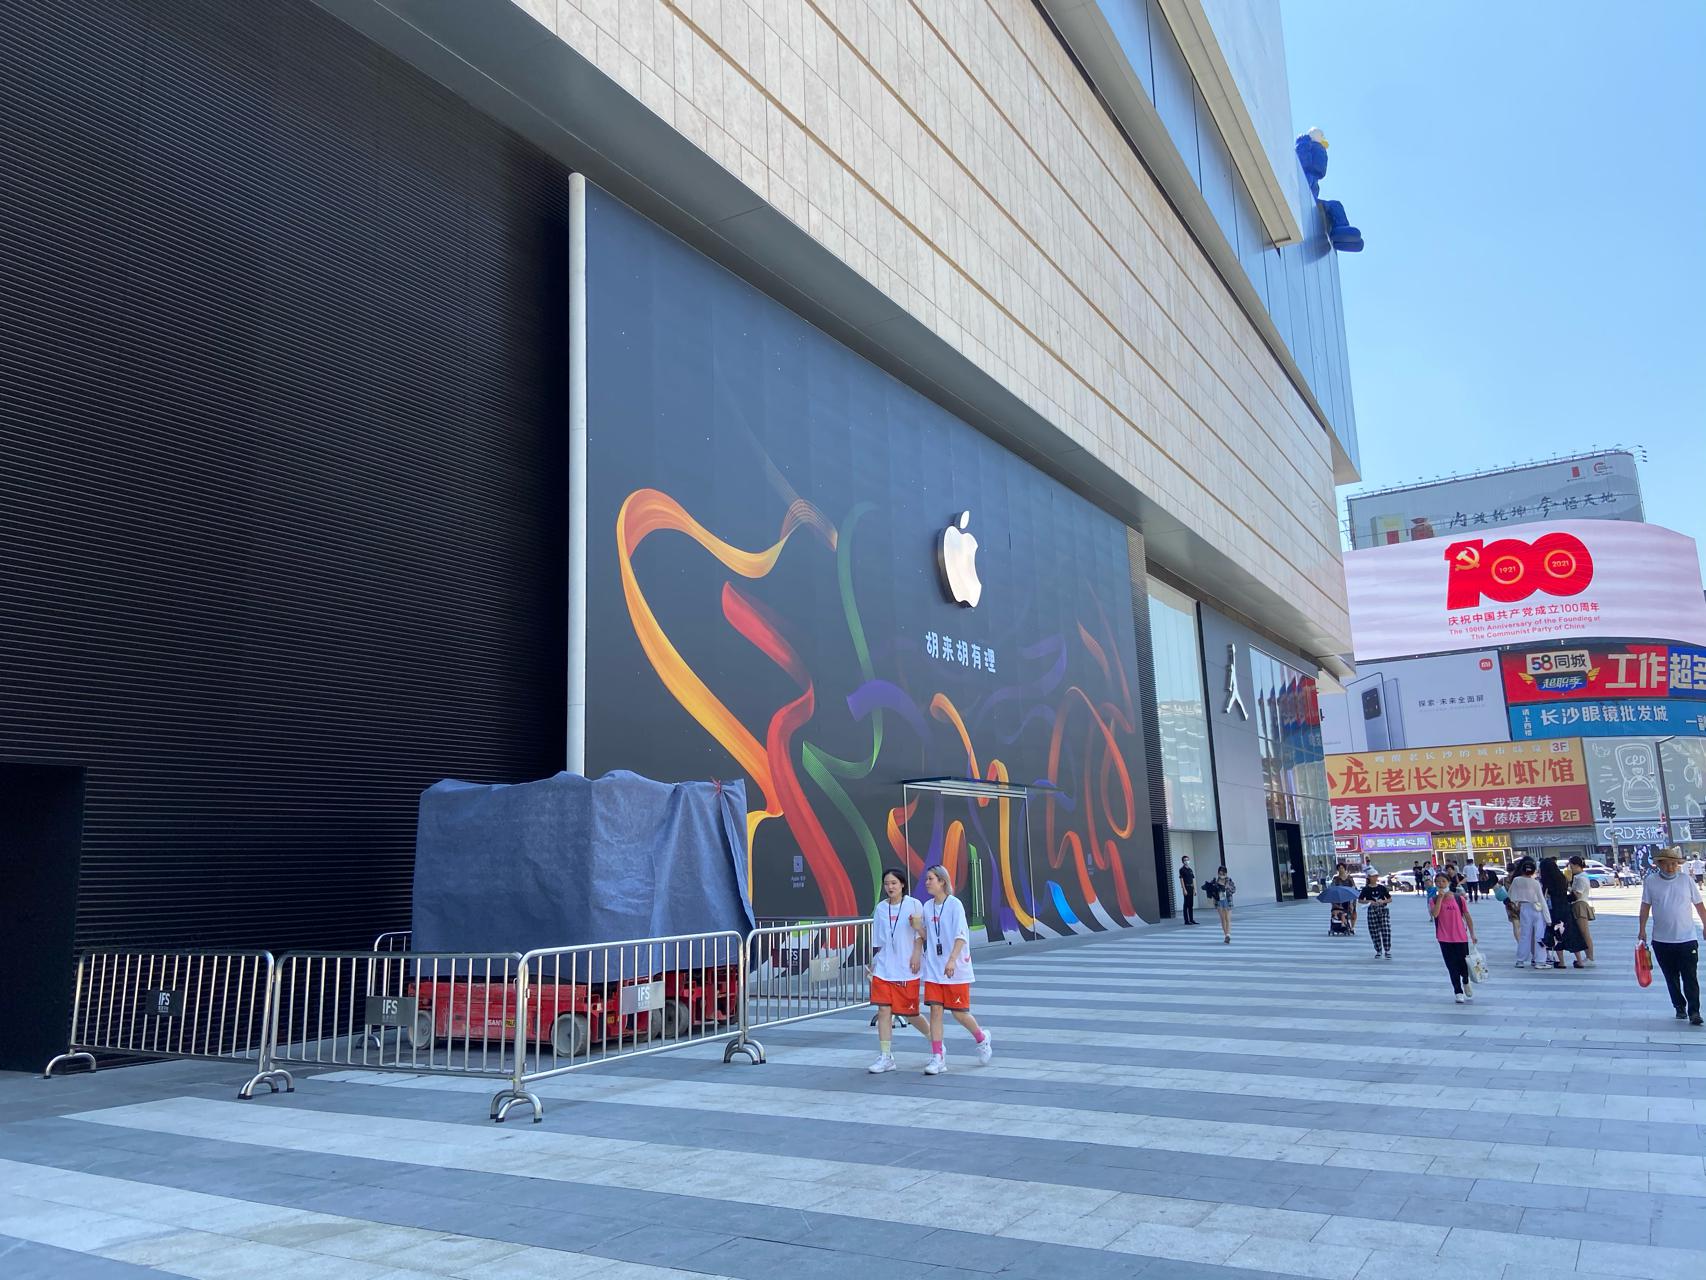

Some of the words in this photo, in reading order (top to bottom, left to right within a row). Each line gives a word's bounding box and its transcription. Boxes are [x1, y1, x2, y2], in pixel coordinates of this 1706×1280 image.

[1499, 566, 1516, 574] 1921
[1552, 560, 1569, 568] 2021
[1448, 602, 1600, 626] 庆祝中国共产党成立100周年
[1465, 625, 1485, 633] 100th
[1487, 620, 1532, 632] Anniversary
[1558, 615, 1593, 624] Founding
[1487, 628, 1530, 639] Communist
[1532, 626, 1551, 635] Party
[1531, 654, 1587, 671] 58同城
[1540, 705, 1669, 726] 长沙眼镜批发城
[1552, 743, 1567, 752] 3F
[1494, 810, 1554, 825] 傣妹爱我
[1562, 811, 1578, 821] 2F
[158, 992, 170, 1006] IFS
[637, 986, 650, 1001] IFS
[382, 999, 398, 1015] IFS
